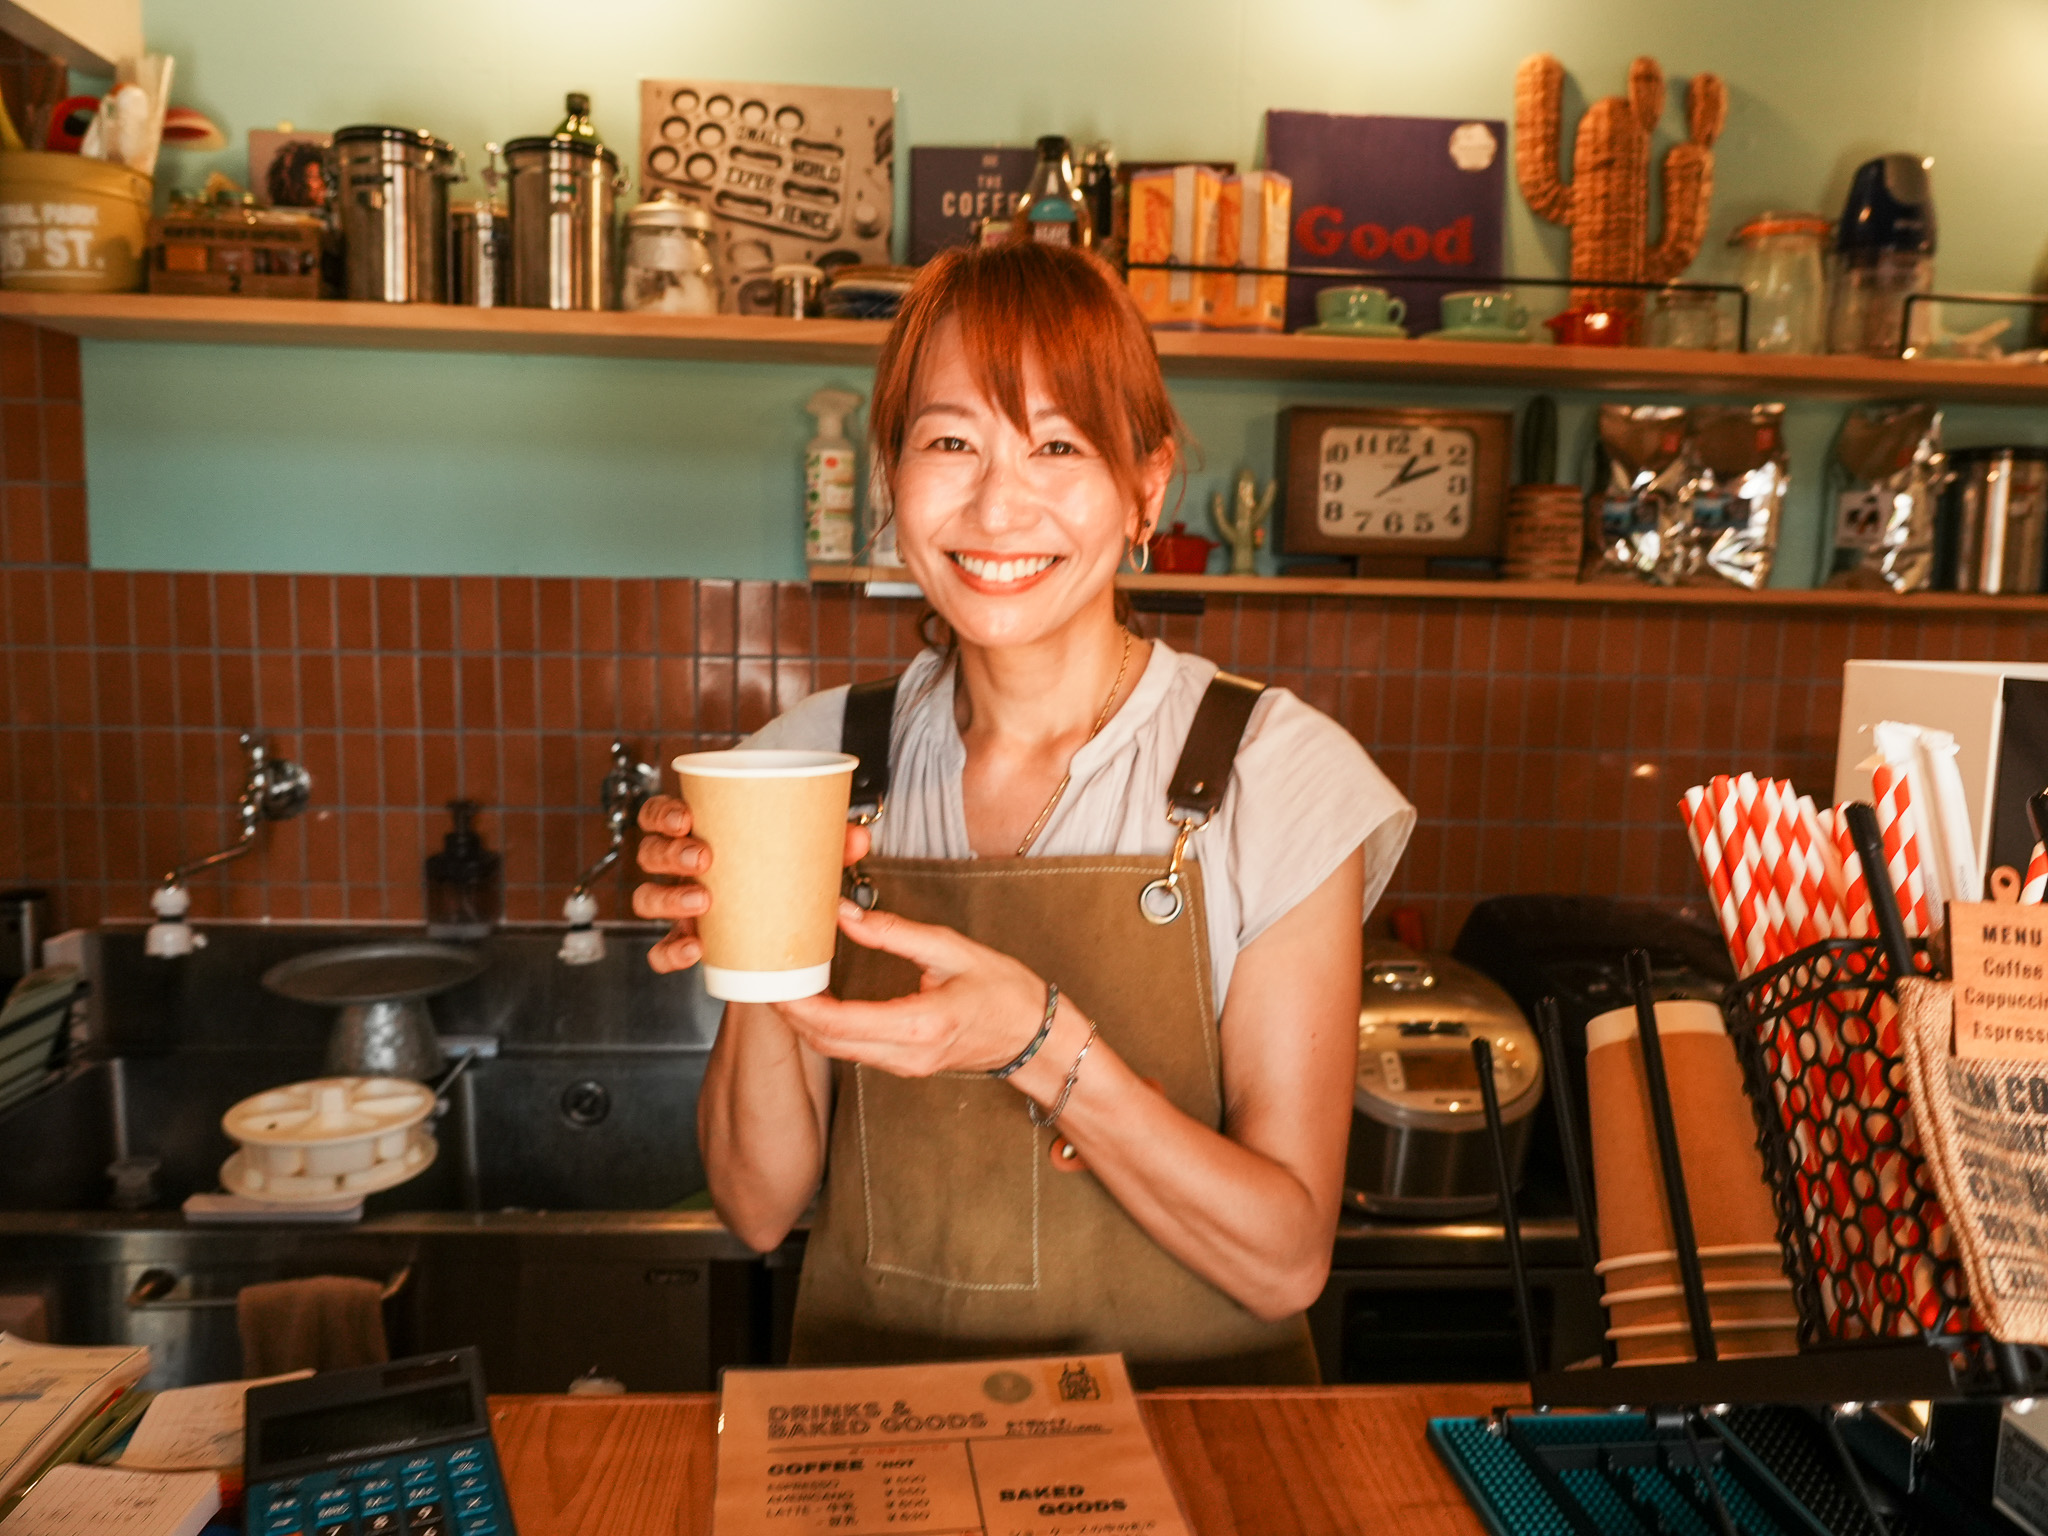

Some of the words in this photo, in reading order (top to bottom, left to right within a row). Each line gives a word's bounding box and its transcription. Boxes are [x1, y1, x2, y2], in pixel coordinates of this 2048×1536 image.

[792, 157, 841, 184] WORLD
[1295, 204, 1475, 266] Good
[1326, 442, 1349, 464] 10
[1356, 434, 1377, 455] 11
[1386, 434, 1410, 454] 12
[1423, 436, 1434, 456] 1
[1448, 445, 1468, 466] 2
[1324, 472, 1343, 492] 9
[1448, 475, 1466, 495] 3
[1324, 501, 1343, 522] 8
[1353, 511, 1373, 532] 7
[1444, 505, 1462, 526] 4
[1383, 512, 1404, 533] 6
[1414, 513, 1434, 533] 5
[1982, 924, 2043, 947] MENU
[1982, 956, 2043, 980] Coffee
[1972, 1020, 2048, 1044] Espress
[767, 1401, 882, 1424] DRINKS
[767, 1418, 871, 1441] BAKED
[880, 1412, 989, 1434] GOODS
[767, 1457, 865, 1477] COFFEE
[999, 1484, 1085, 1502] BAKED
[1037, 1497, 1127, 1516] GOODS
